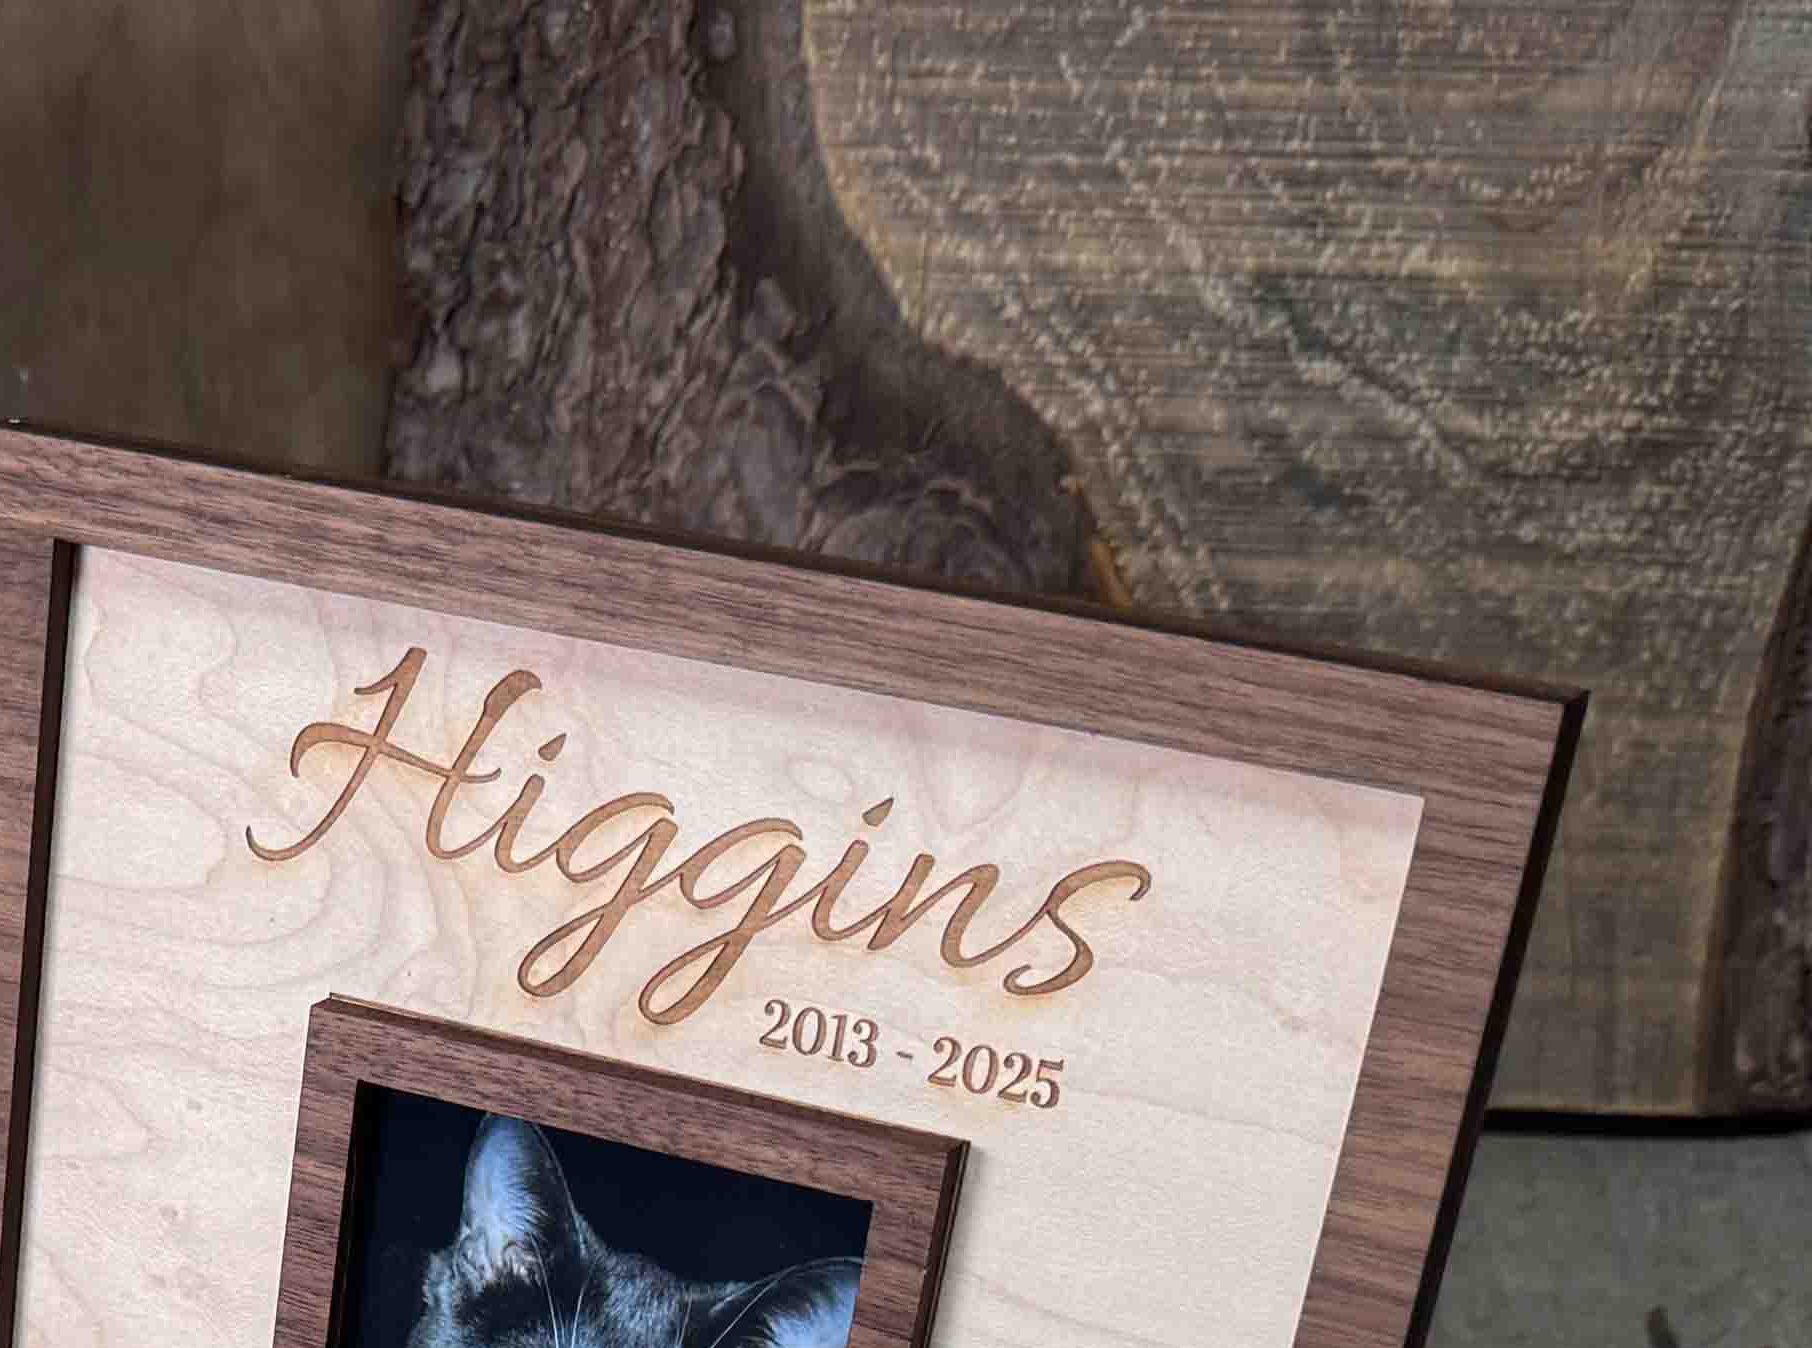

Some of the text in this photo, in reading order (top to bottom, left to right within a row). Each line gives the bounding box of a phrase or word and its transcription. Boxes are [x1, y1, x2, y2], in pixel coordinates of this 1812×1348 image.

[245, 647, 1152, 1027] Higgins
[758, 999, 881, 1069] 2013
[928, 1035, 1066, 1110] 2025
